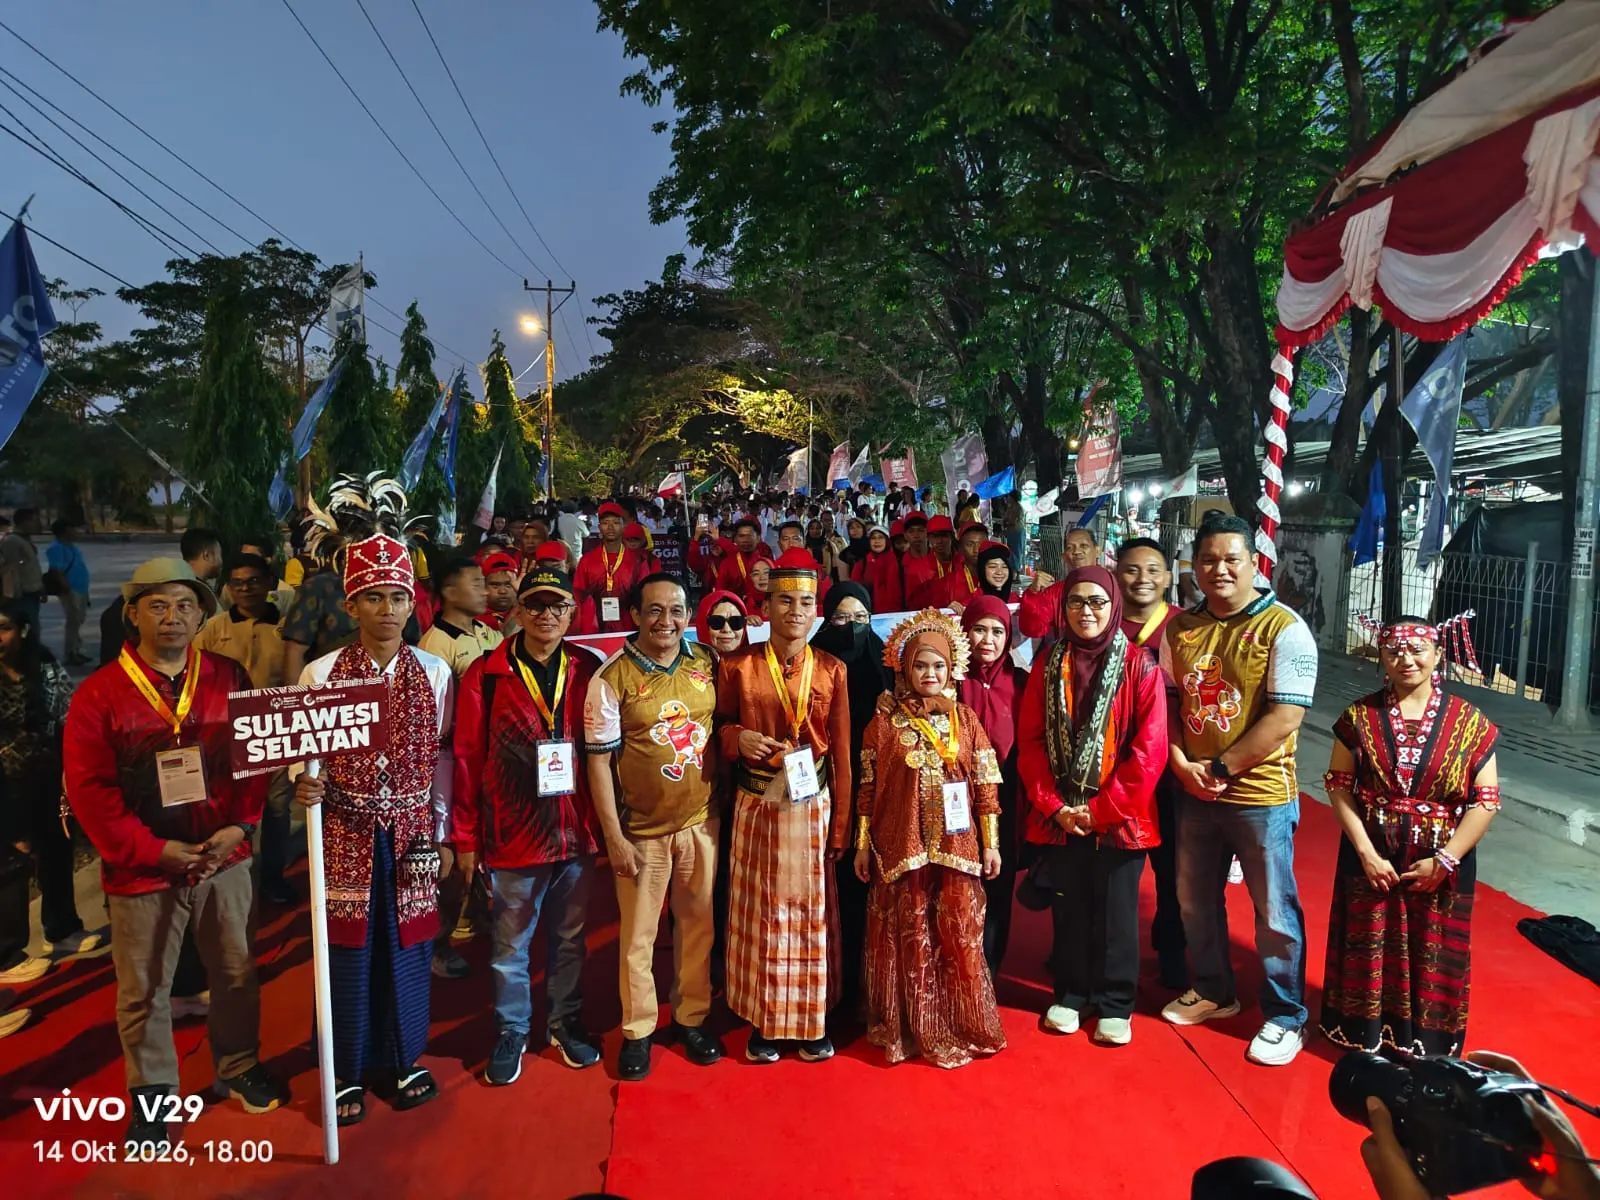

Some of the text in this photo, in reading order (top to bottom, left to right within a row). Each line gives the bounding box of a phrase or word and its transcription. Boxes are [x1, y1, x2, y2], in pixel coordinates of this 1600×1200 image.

[674, 462, 690, 471] NTT
[233, 701, 380, 740] SULAWESI
[246, 725, 370, 763] SELATAN
